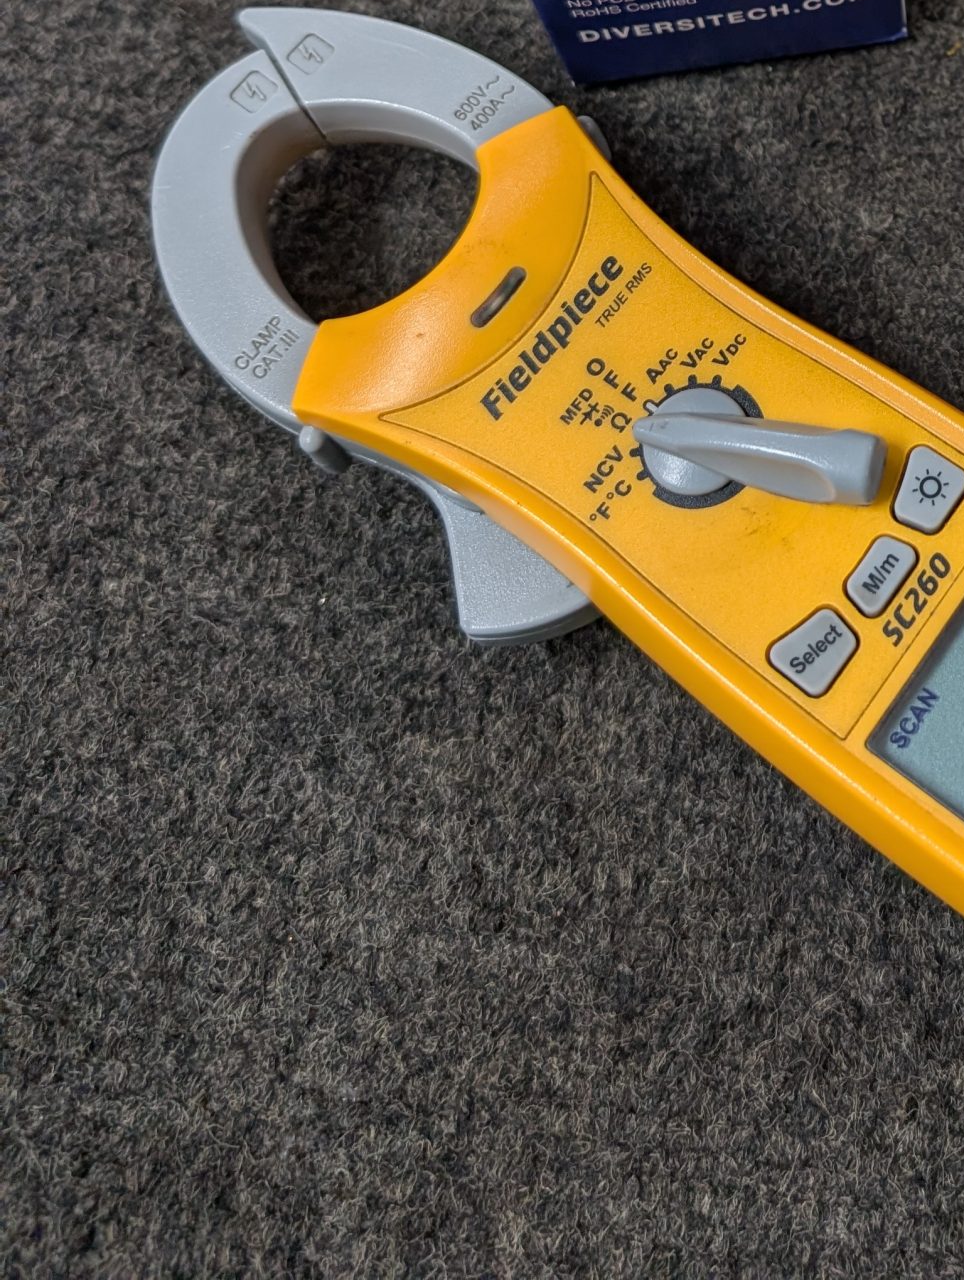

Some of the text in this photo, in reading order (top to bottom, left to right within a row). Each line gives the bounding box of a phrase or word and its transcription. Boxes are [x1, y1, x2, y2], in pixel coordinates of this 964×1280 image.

[571, 5, 621, 18] RoHS
[595, 262, 653, 328] TRUE RMS
[233, 314, 284, 372] CLAMP
[479, 256, 623, 421] Fieldpiece
[559, 387, 593, 426] MFD
[585, 357, 637, 403] OFF
[583, 444, 623, 494] NCV
[861, 552, 900, 596] M/m
[882, 552, 952, 647] SC260
[789, 623, 843, 676] Select
[889, 687, 939, 749] SCAN
